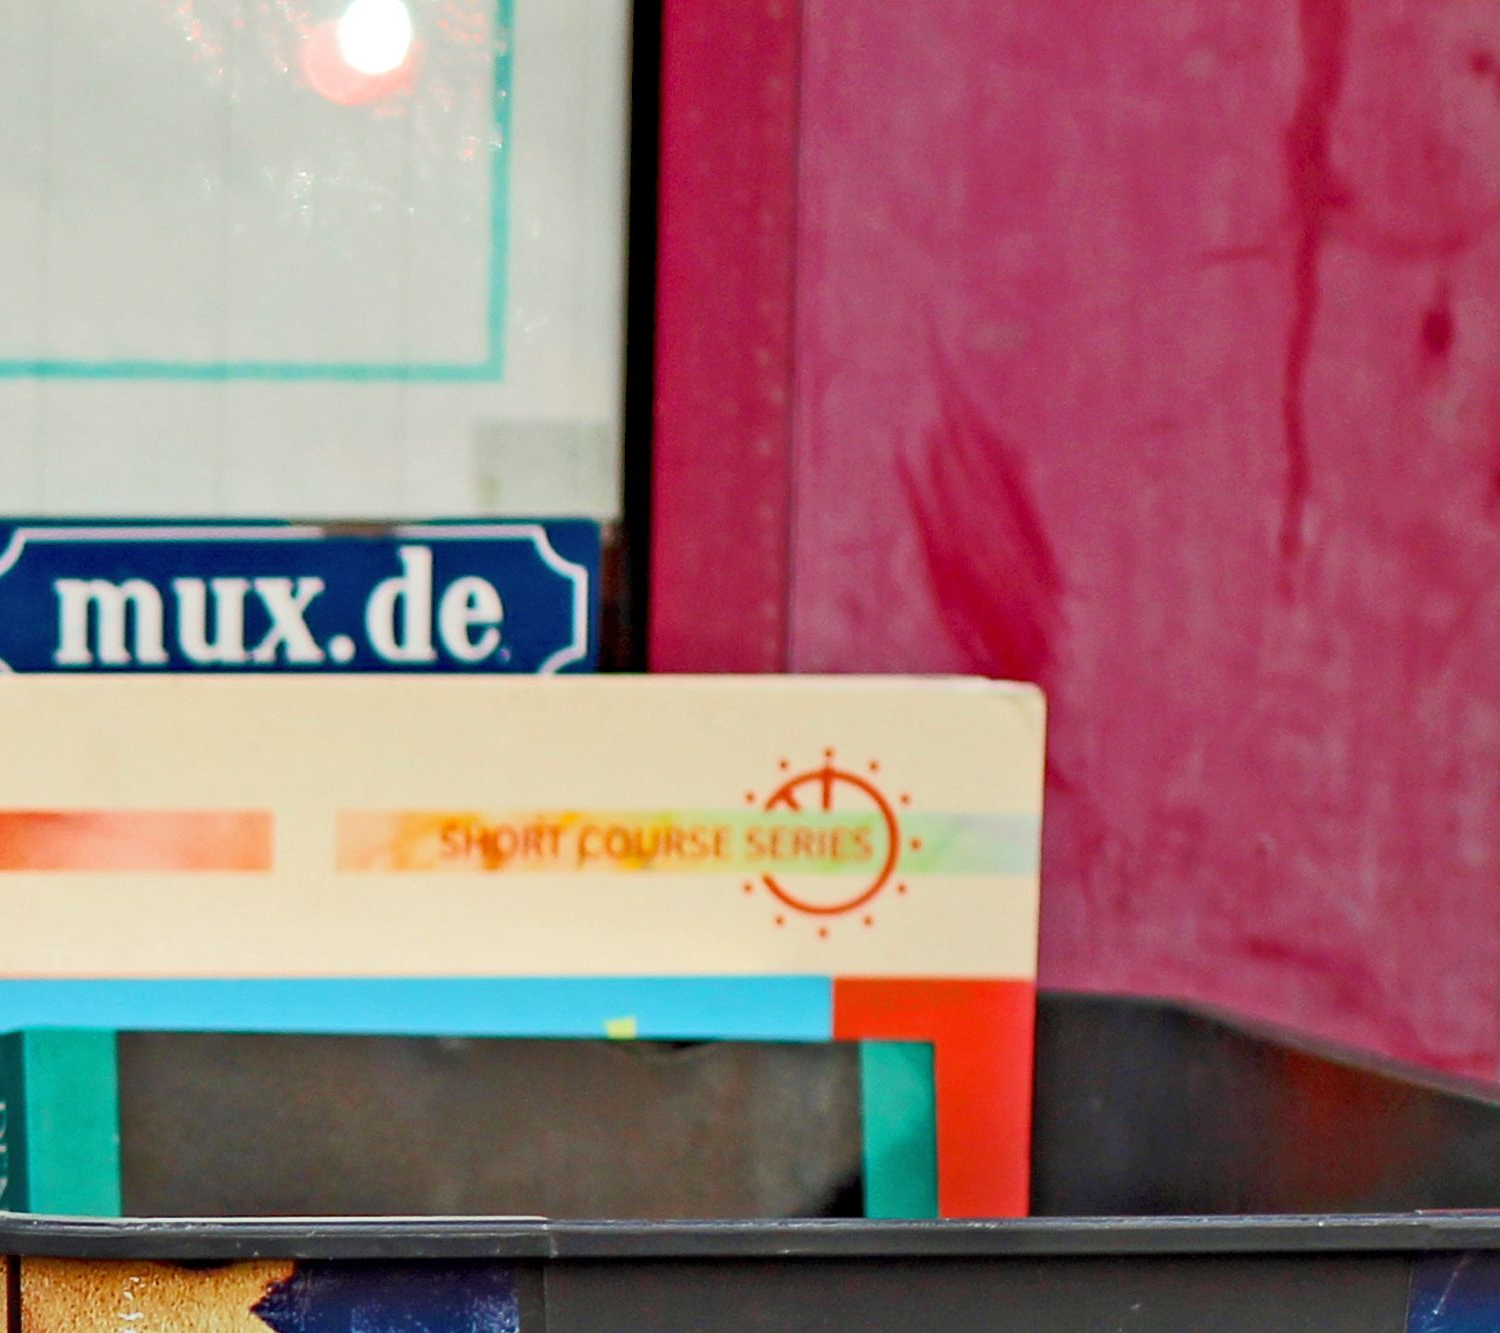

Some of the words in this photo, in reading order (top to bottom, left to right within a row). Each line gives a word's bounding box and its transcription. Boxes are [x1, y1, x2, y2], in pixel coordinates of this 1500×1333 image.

[54, 545, 504, 665] mux.de
[439, 824, 563, 862] SHORT
[578, 824, 728, 860] COURSE
[745, 824, 873, 861] SERIES
